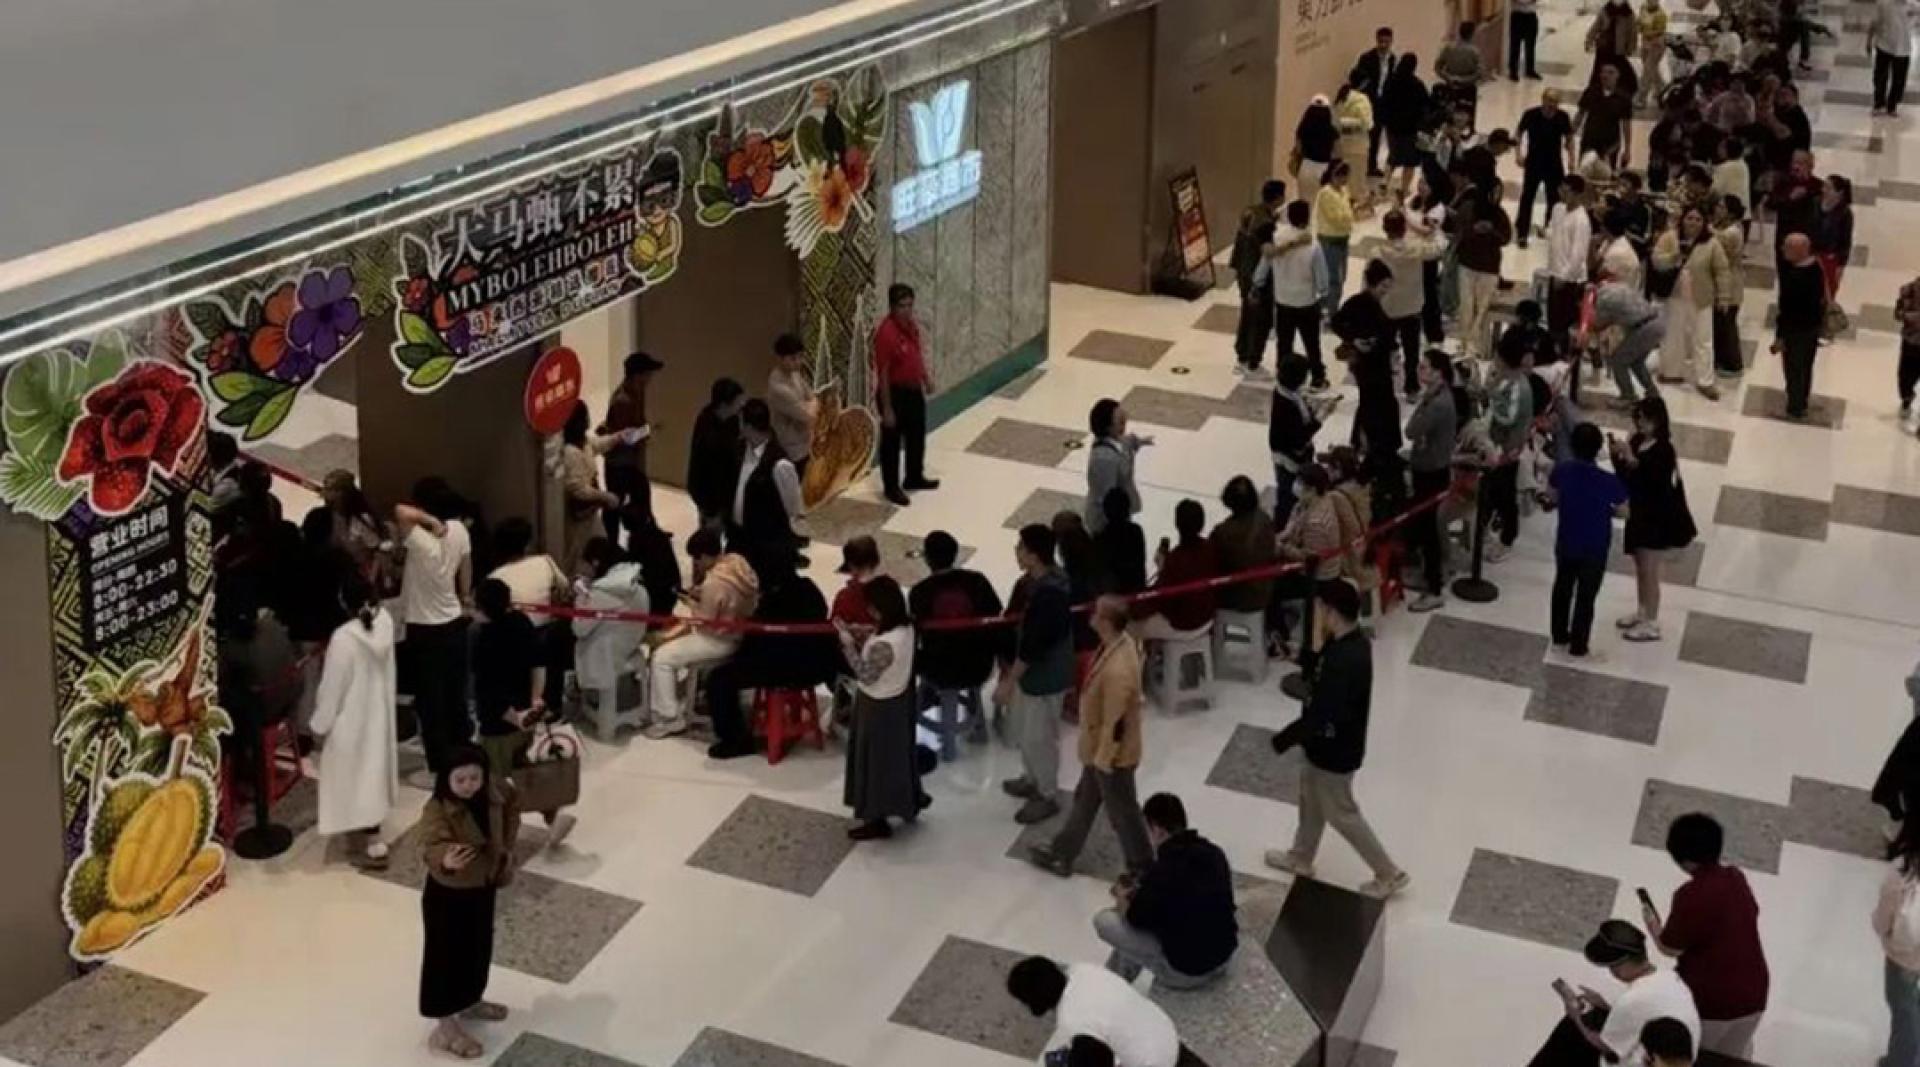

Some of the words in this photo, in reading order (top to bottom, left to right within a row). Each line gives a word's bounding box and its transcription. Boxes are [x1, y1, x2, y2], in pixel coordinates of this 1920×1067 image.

[449, 220, 633, 311] MYBOLEHBOLEH
[89, 505, 168, 559] 营业时间
[94, 558, 177, 609] 8:00-22:30
